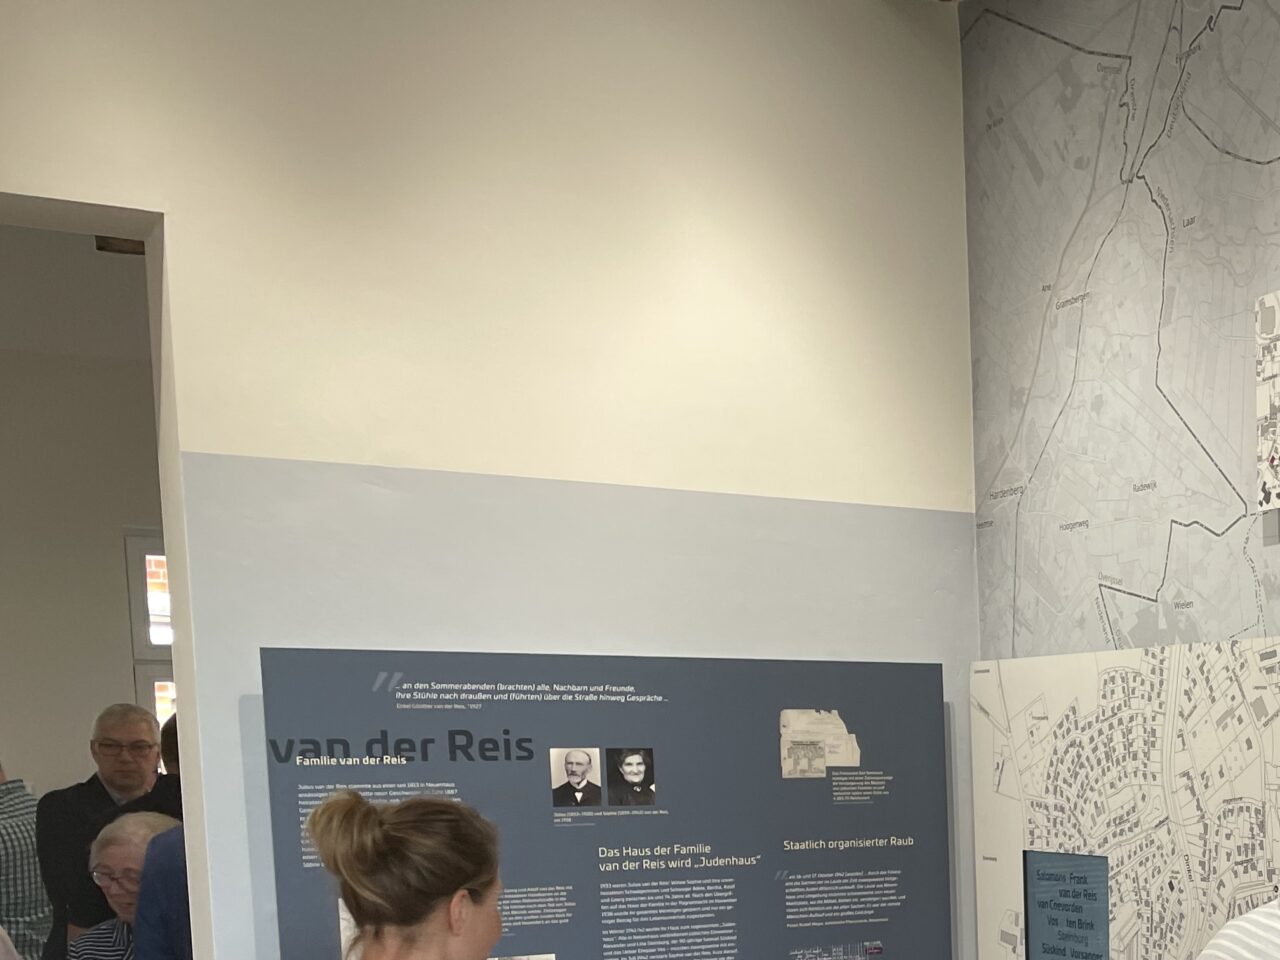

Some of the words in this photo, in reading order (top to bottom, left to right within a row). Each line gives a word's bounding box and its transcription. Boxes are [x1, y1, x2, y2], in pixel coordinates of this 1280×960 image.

[1182, 215, 1196, 228] Laar
[1174, 600, 1194, 610] Wielen
[414, 682, 429, 690] den
[589, 684, 604, 692] und
[440, 692, 458, 700] nach
[493, 692, 508, 700] und
[562, 693, 572, 701] die
[574, 693, 598, 701] Straße
[268, 737, 350, 764] van
[365, 730, 435, 764] der
[447, 729, 534, 762] Reis
[296, 756, 338, 766] Familie
[339, 757, 359, 765] van
[362, 755, 381, 765] der
[383, 755, 407, 765] Reis
[783, 839, 826, 850] Staatlich
[828, 838, 888, 851] organisierter
[890, 836, 914, 846] Raub
[598, 847, 620, 858] Das
[623, 846, 652, 857] Haus
[654, 844, 672, 856] der
[674, 843, 711, 855] Familie
[599, 861, 620, 871] van
[622, 859, 640, 870] der
[643, 858, 666, 870] Reis
[668, 857, 691, 869] wird
[1069, 872, 1088, 885] Frank
[1059, 888, 1071, 898] van
[1072, 887, 1082, 899] der
[1083, 889, 1098, 902] Reis
[1037, 900, 1048, 910] van
[1047, 915, 1059, 927] Vos
[1066, 916, 1077, 929] ten
[1078, 918, 1095, 931] Brink
